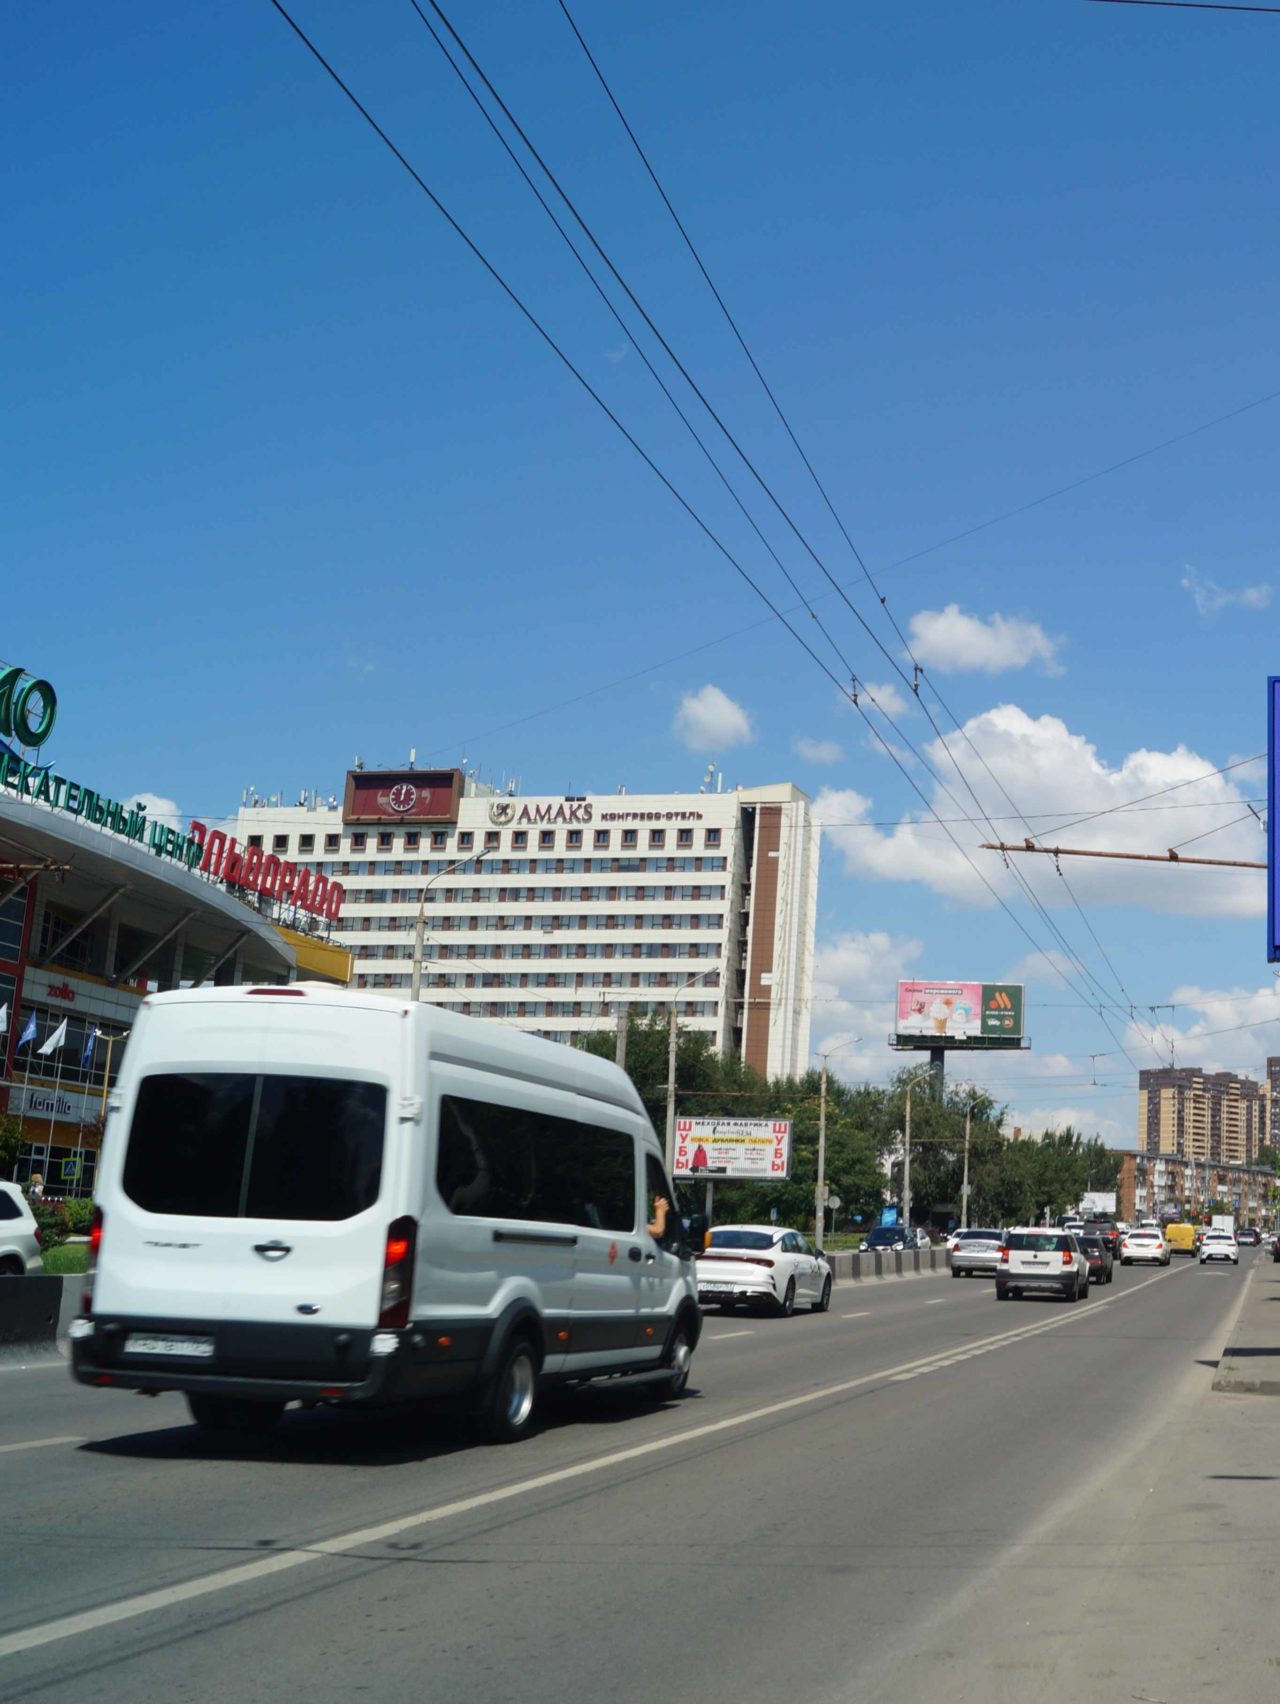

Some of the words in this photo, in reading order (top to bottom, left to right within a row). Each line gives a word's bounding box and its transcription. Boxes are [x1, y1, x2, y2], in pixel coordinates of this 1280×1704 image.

[517, 803, 593, 825] AMAKS
[601, 810, 703, 822] КОНГРЕСС-ОТЕЛЬ
[149, 820, 204, 869] ЦЕНТР
[47, 981, 75, 1002] zolla
[676, 1121, 692, 1169] ШУБЫ
[771, 1122, 788, 1172] ШУБЫ
